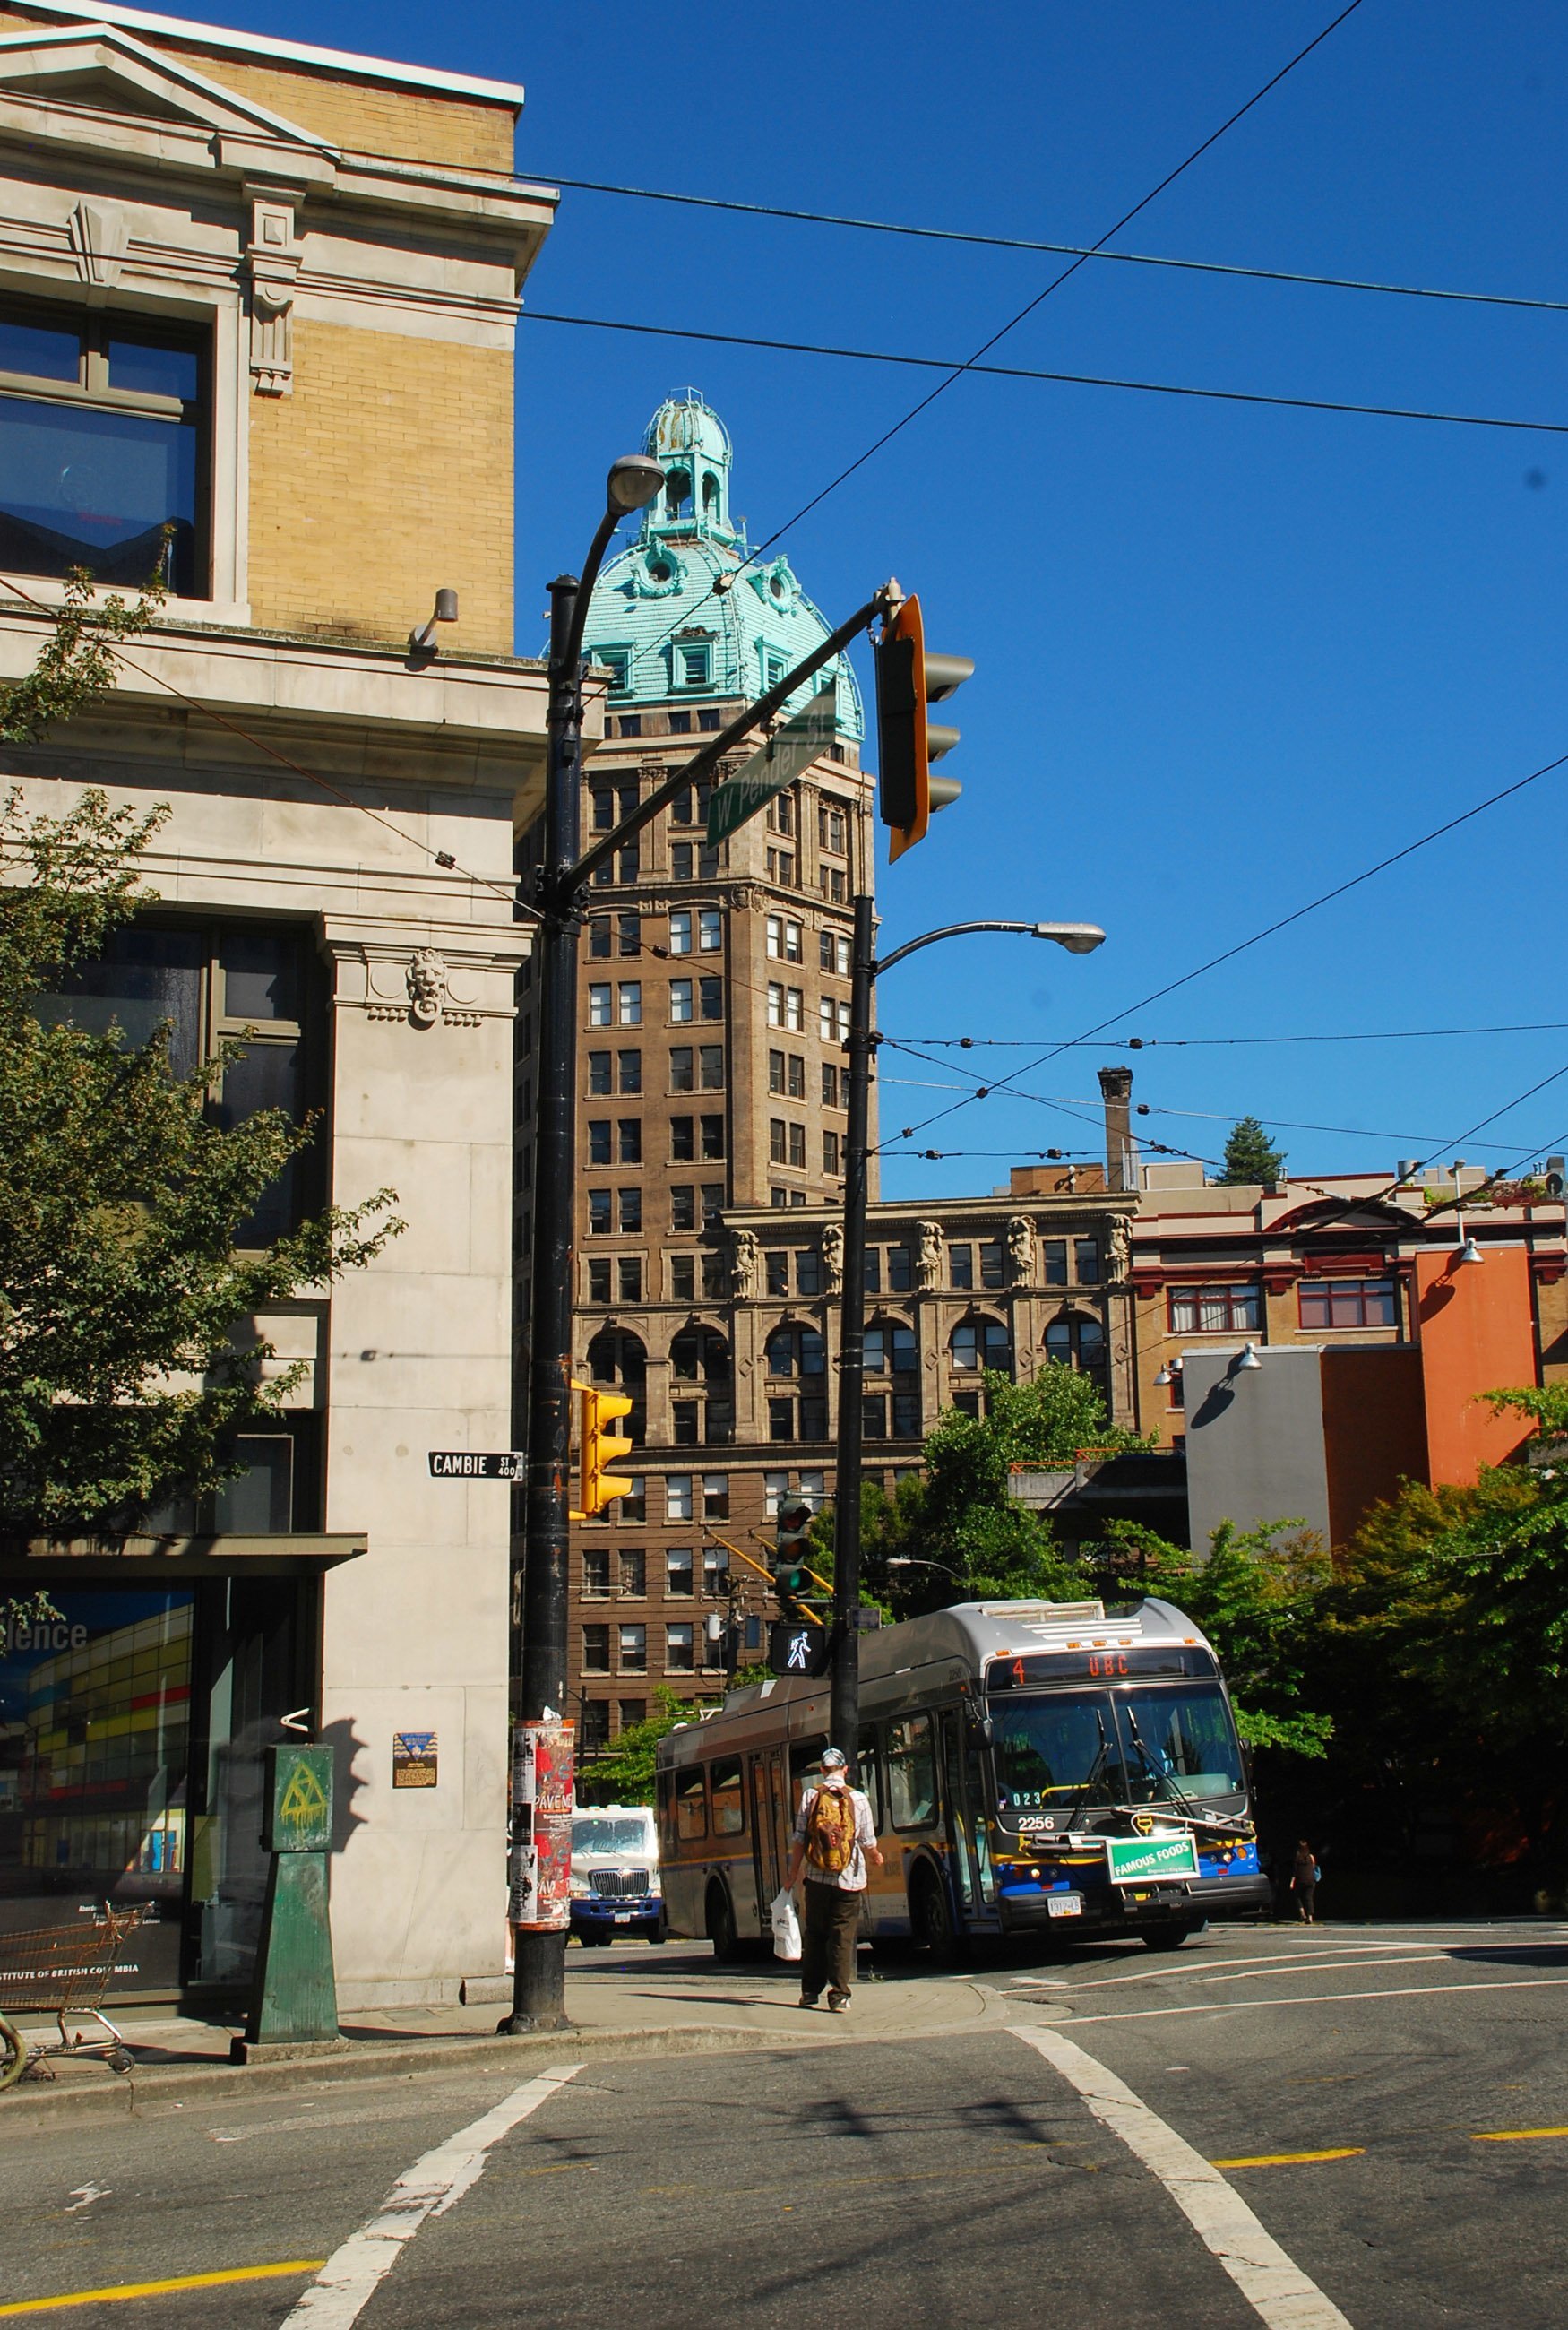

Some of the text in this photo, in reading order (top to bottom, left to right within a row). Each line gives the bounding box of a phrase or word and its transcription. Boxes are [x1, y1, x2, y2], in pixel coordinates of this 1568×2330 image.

[718, 703, 825, 832] W Pender St
[434, 1454, 487, 1475] CAMBIE
[500, 1457, 510, 1467] ST
[498, 1467, 515, 1476] 400
[1012, 1655, 1129, 1686] 4 UBC
[1018, 1816, 1055, 1832] 2256
[1115, 1841, 1190, 1877] FAMOUS FOODS
[38, 1970, 49, 1978] OF
[51, 1967, 88, 1978] BRITISH
[90, 1964, 139, 1975] COMBIA
